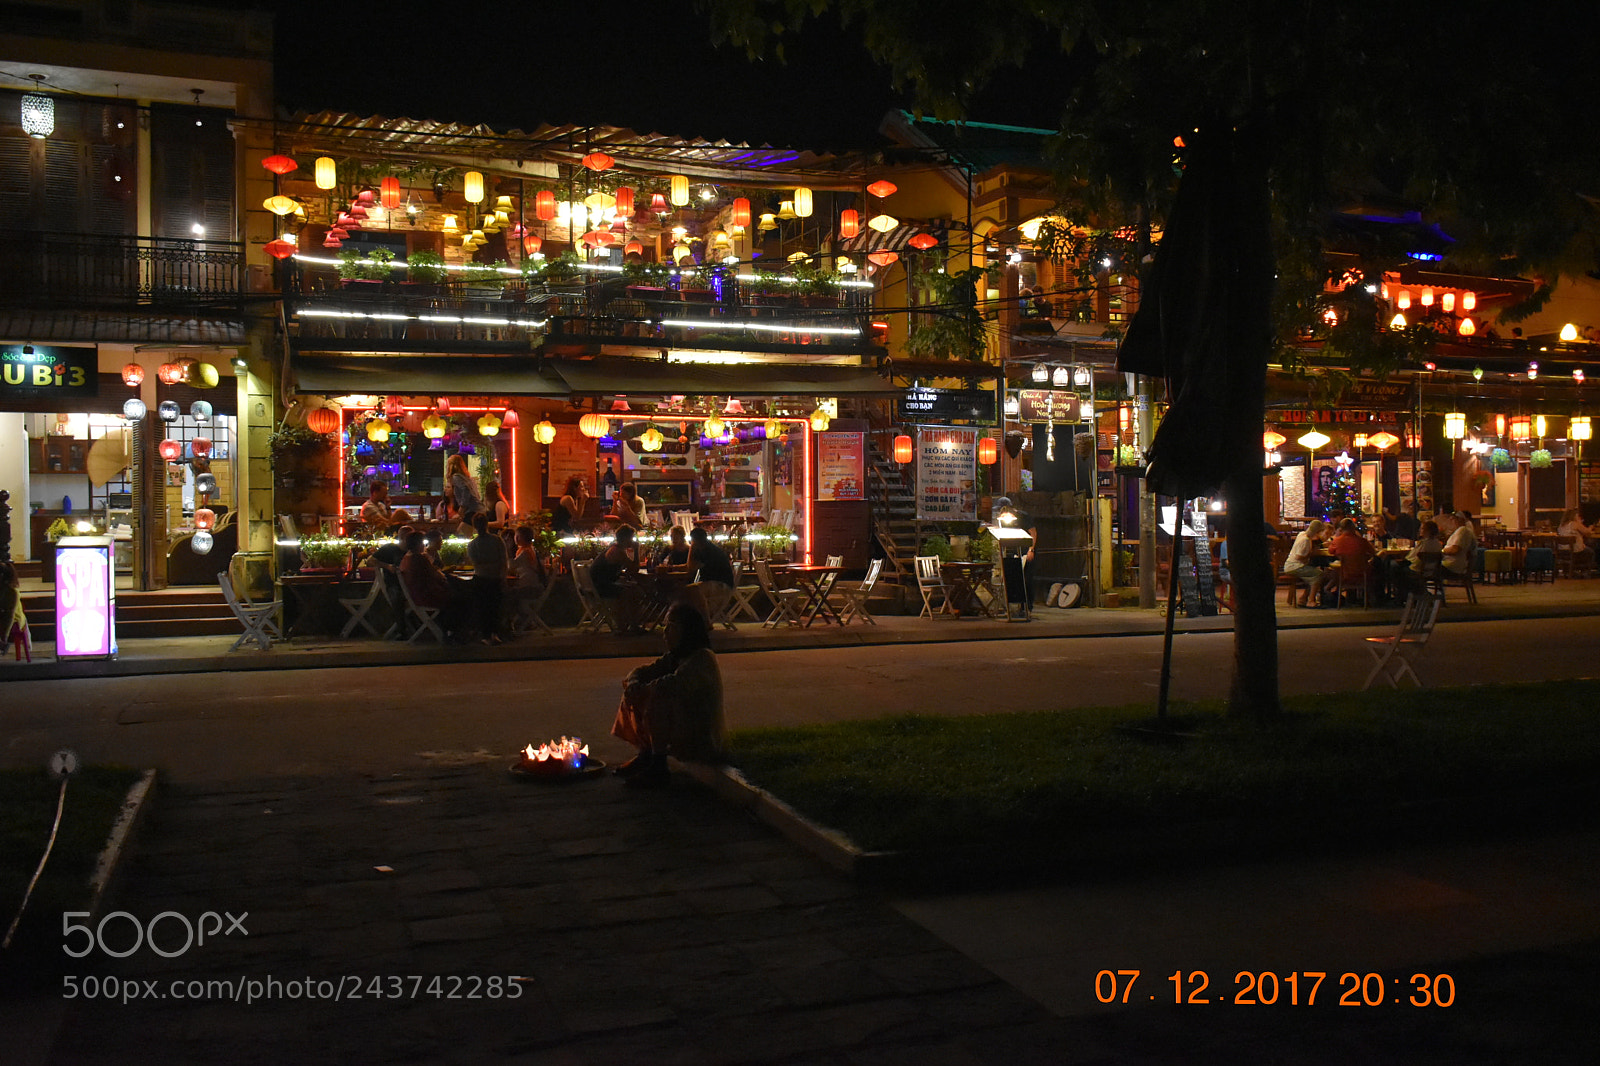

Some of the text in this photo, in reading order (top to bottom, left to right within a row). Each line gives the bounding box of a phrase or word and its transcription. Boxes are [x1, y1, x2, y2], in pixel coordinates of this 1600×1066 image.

[0, 364, 25, 385] U
[69, 366, 86, 387] 3
[61, 556, 106, 609] SPA
